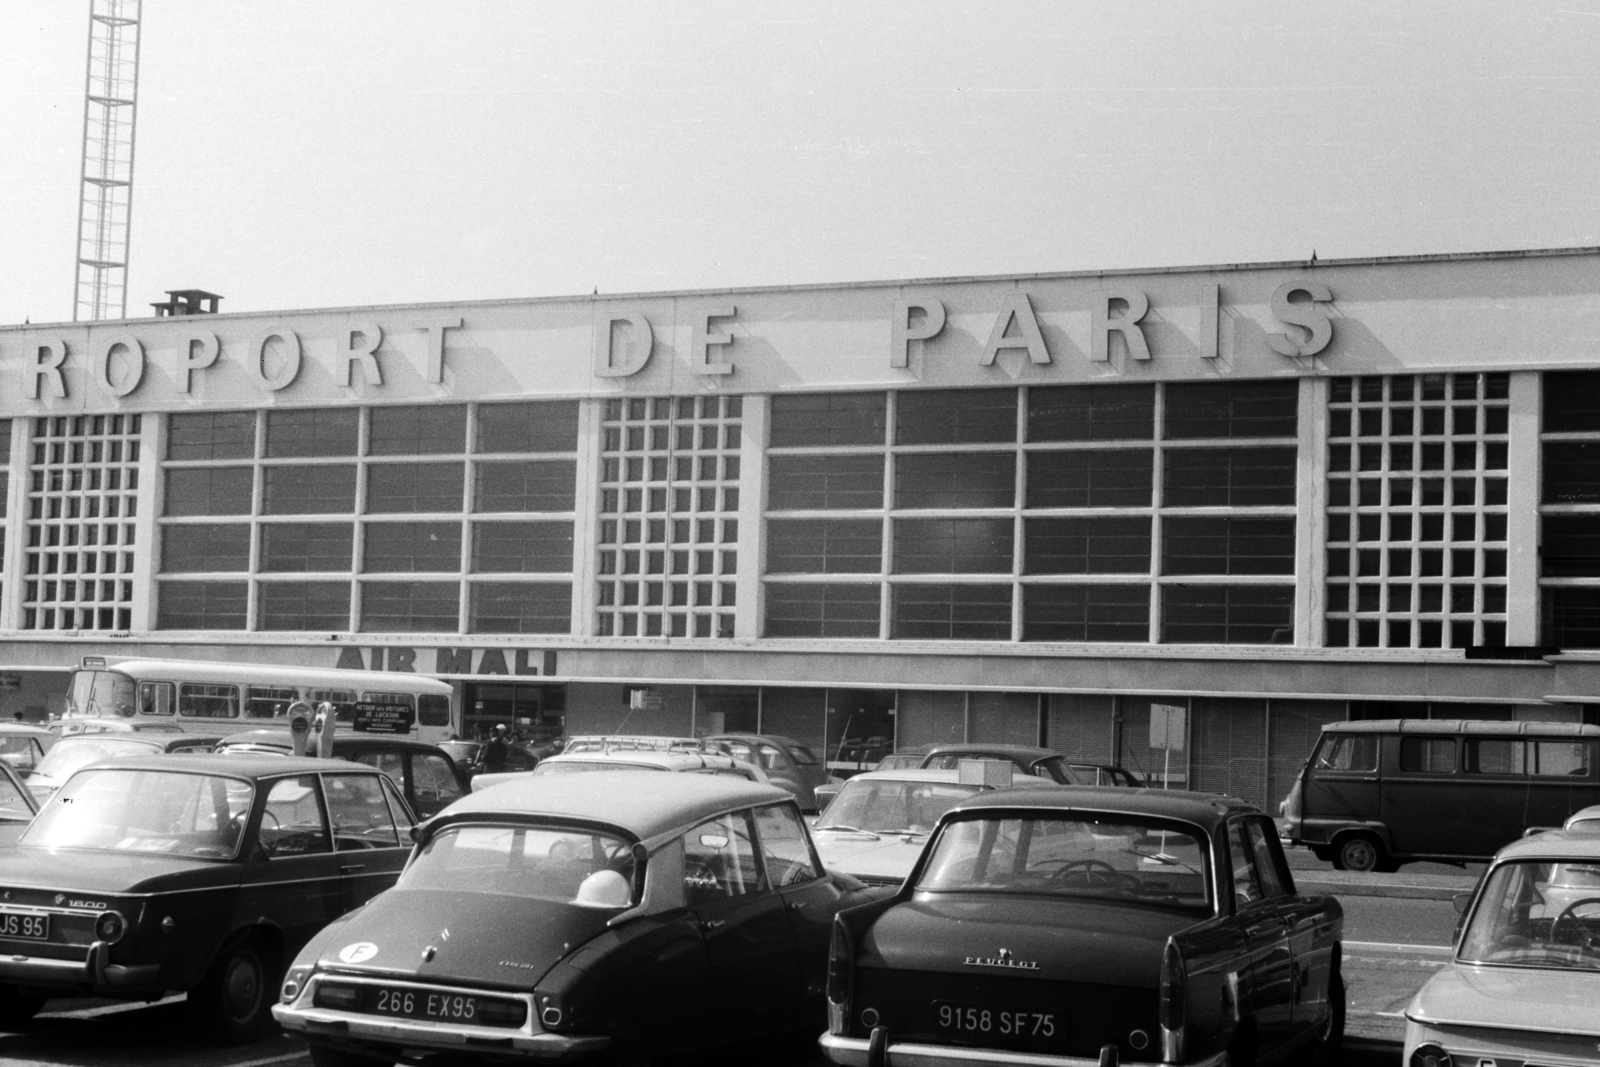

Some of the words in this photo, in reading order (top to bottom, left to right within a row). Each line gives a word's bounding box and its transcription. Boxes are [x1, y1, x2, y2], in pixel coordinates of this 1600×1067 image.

[26, 316, 463, 400] ROPORT
[596, 308, 740, 378] DE
[891, 280, 1333, 368] PARIS
[336, 647, 416, 673] AIR
[436, 648, 557, 677] MALI
[68, 899, 107, 909] 1600
[23, 917, 43, 936] 95
[350, 945, 370, 959] F
[965, 956, 1039, 969] PEUGEOT
[377, 990, 415, 1013] 266
[939, 1005, 992, 1032] 9158
